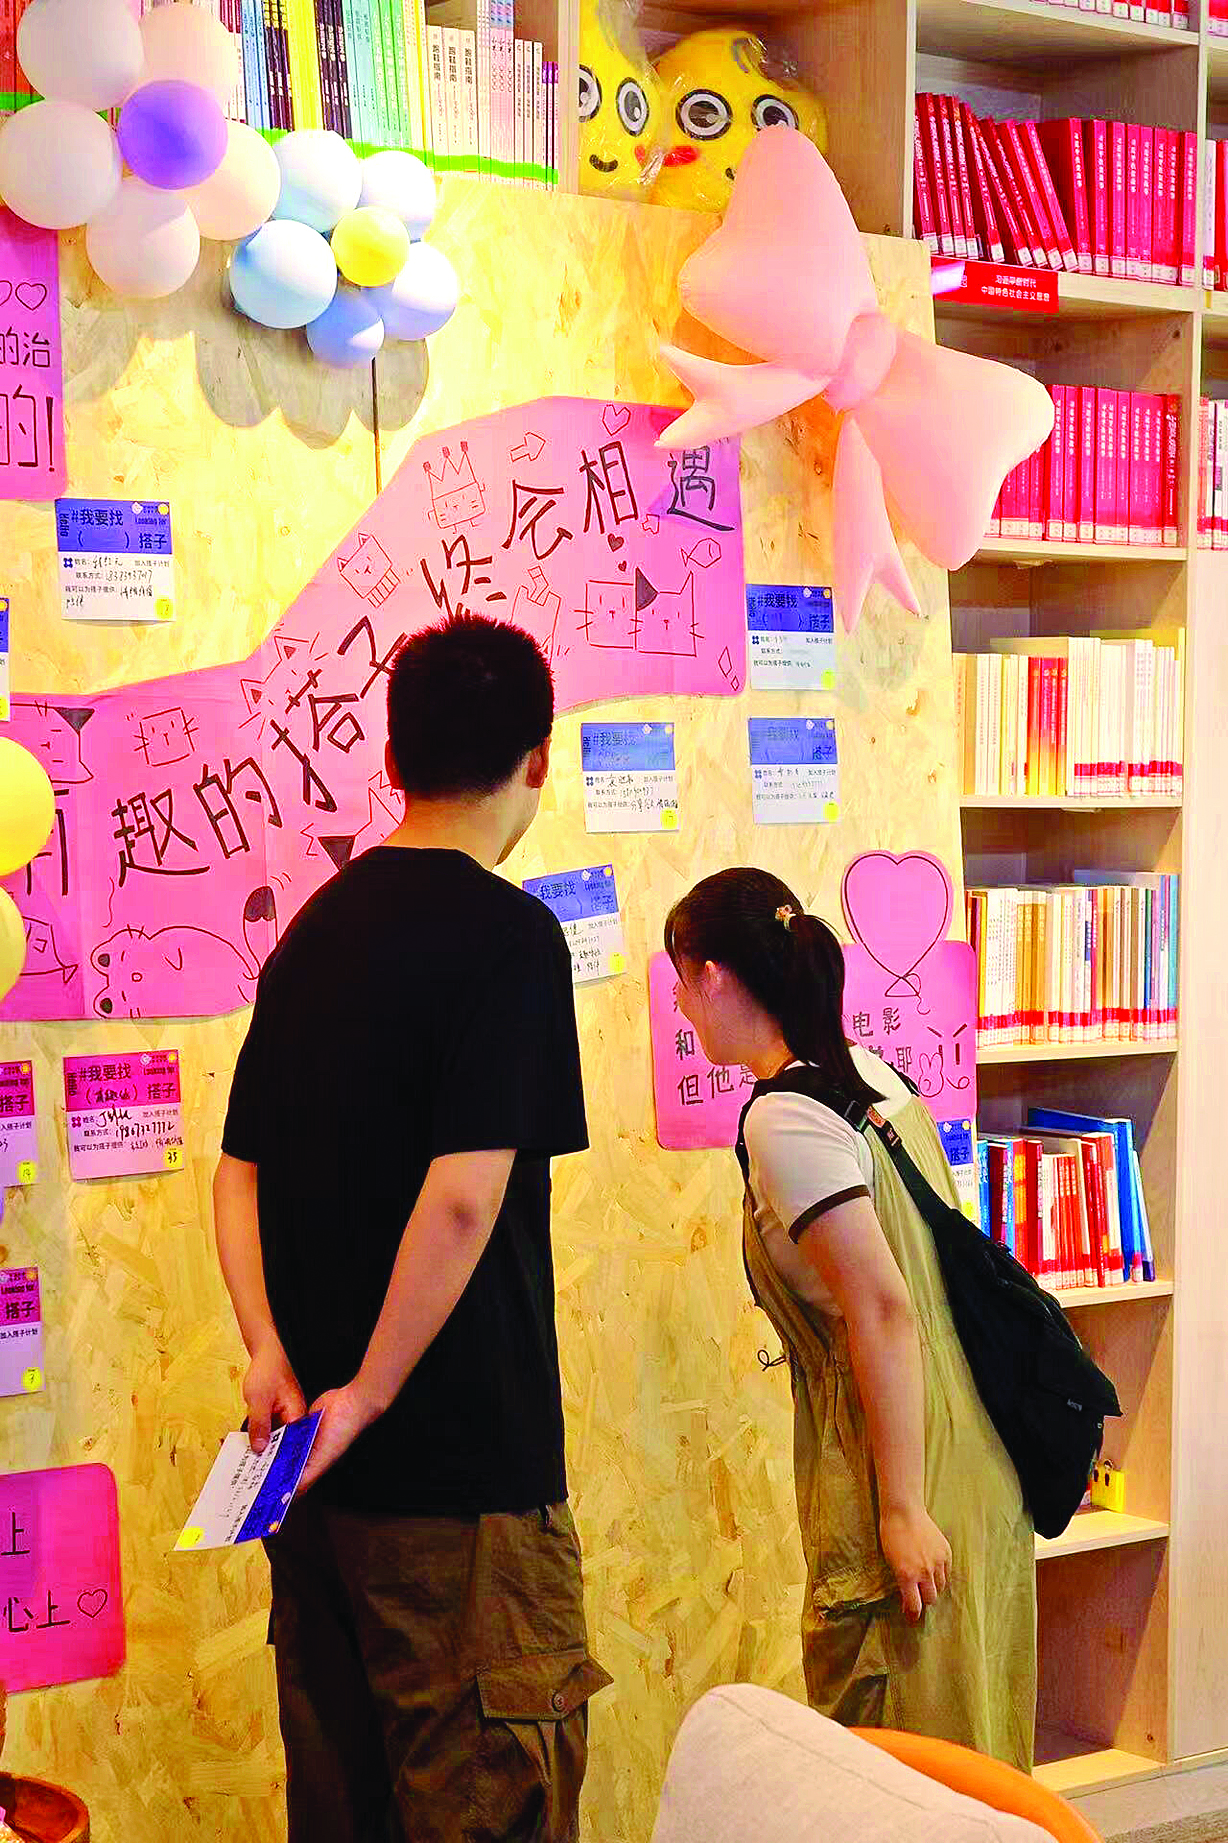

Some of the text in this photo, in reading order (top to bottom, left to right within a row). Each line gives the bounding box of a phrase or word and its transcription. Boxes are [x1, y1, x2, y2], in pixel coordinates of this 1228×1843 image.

[139, 532, 167, 549] 搭子
[147, 1082, 176, 1100] 搭子
[6, 1300, 35, 1320] 搭子
[1, 1512, 30, 1556] 上
[3, 1590, 71, 1632] 心上
